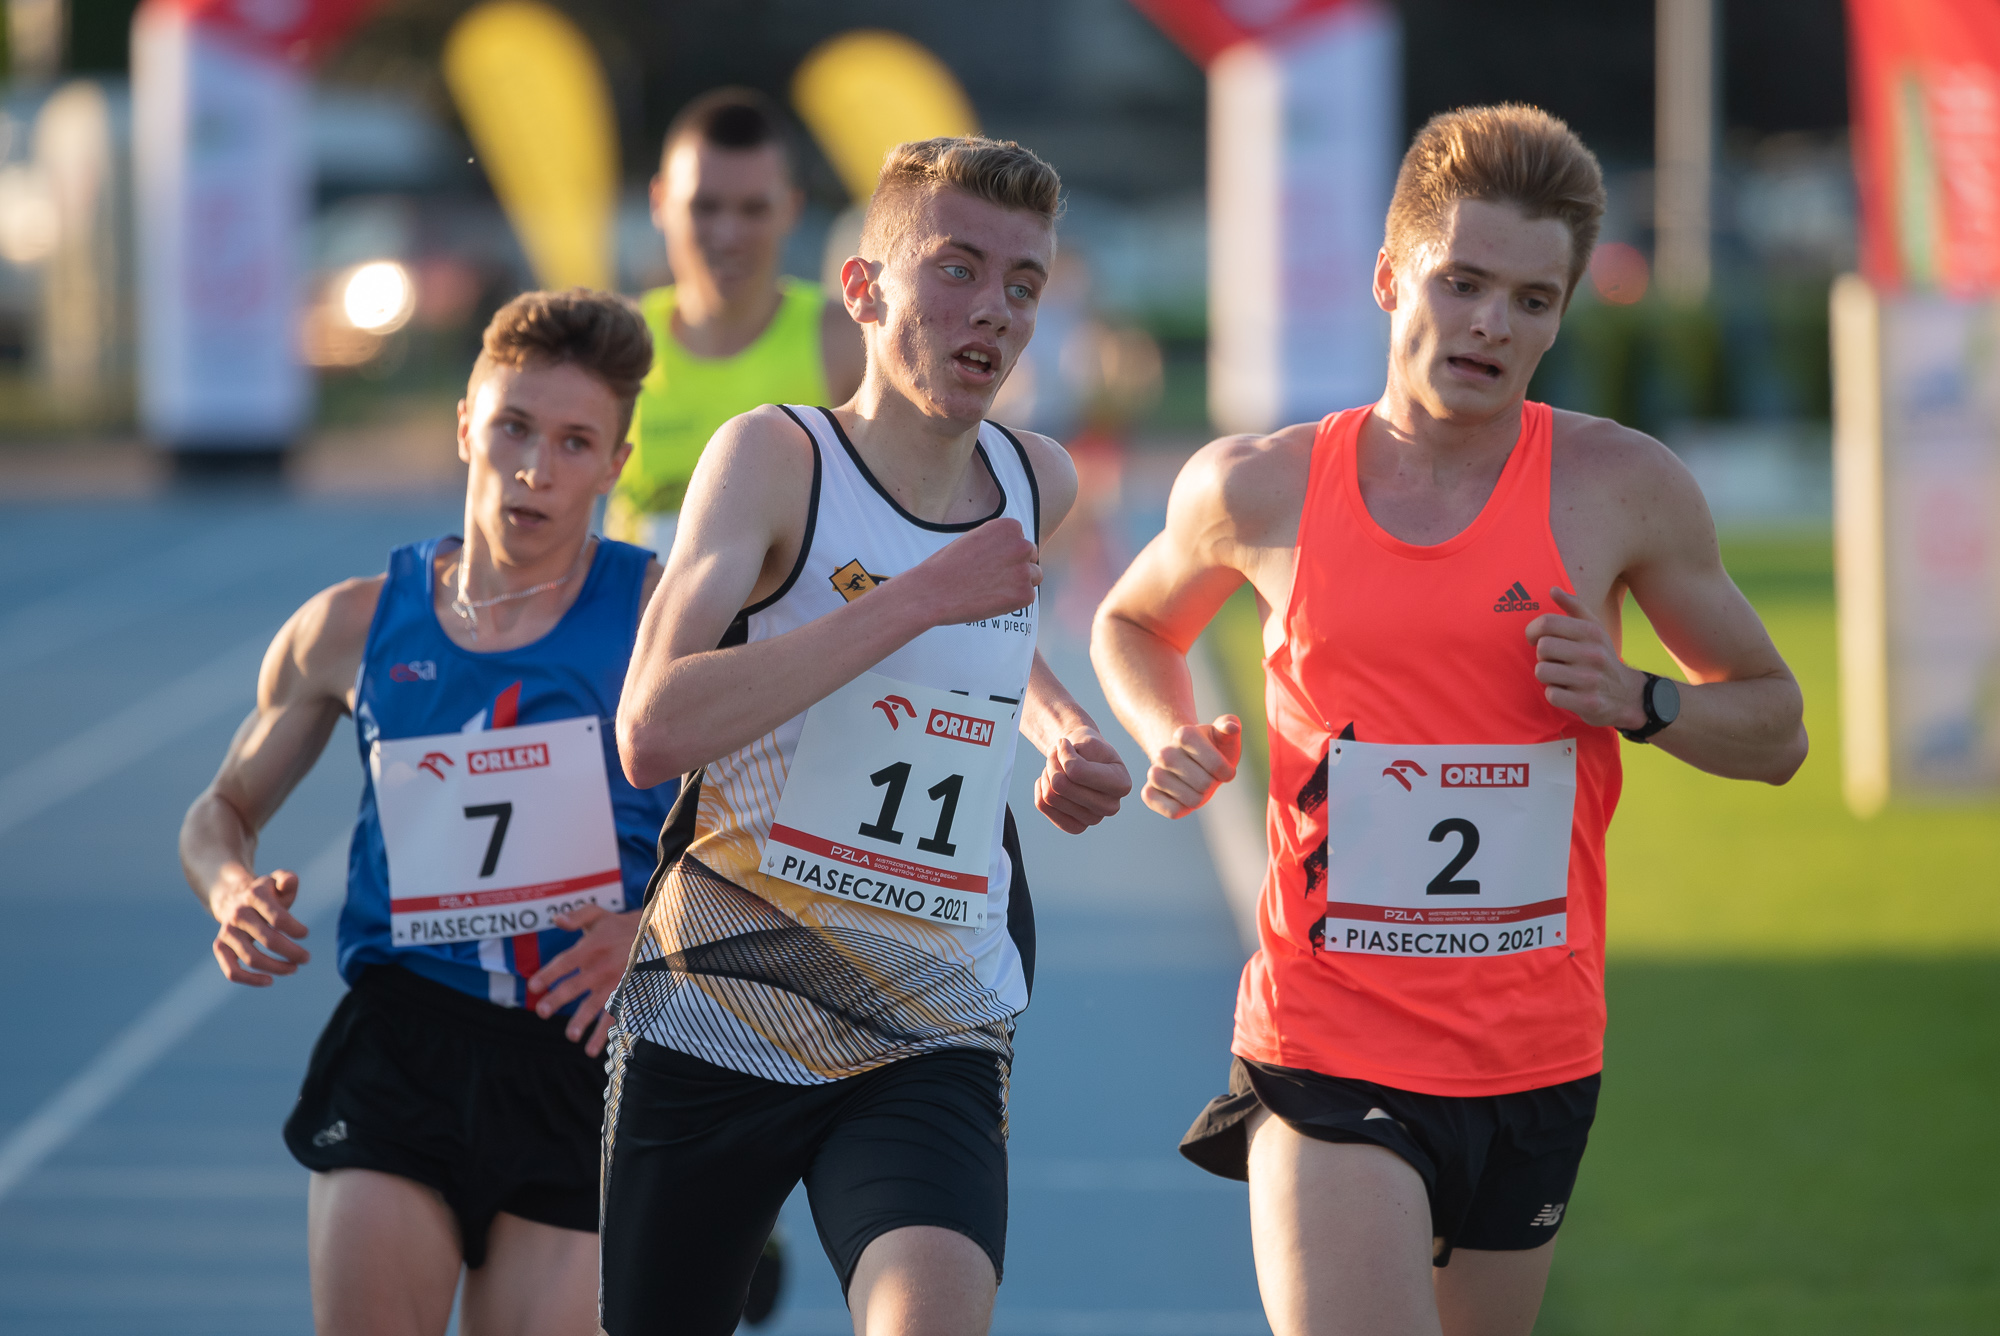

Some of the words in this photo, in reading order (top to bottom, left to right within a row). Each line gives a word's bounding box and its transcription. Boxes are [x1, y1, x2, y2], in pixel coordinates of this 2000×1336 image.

[1493, 600, 1540, 613] adidas
[930, 713, 992, 743] ORLEN
[470, 746, 547, 773] ORLEN
[1445, 767, 1525, 785] ORLEN
[858, 761, 964, 857] 11
[464, 802, 512, 878] 7
[830, 845, 870, 866] PZLA
[1426, 817, 1480, 895] 2
[781, 855, 925, 913] PIASECZNO
[930, 896, 968, 922] 2021
[410, 909, 538, 941] PIASECZNO
[1384, 909, 1424, 922] PZLA
[1346, 928, 1489, 954] PIASECZNO
[1497, 926, 1543, 952] 2021
